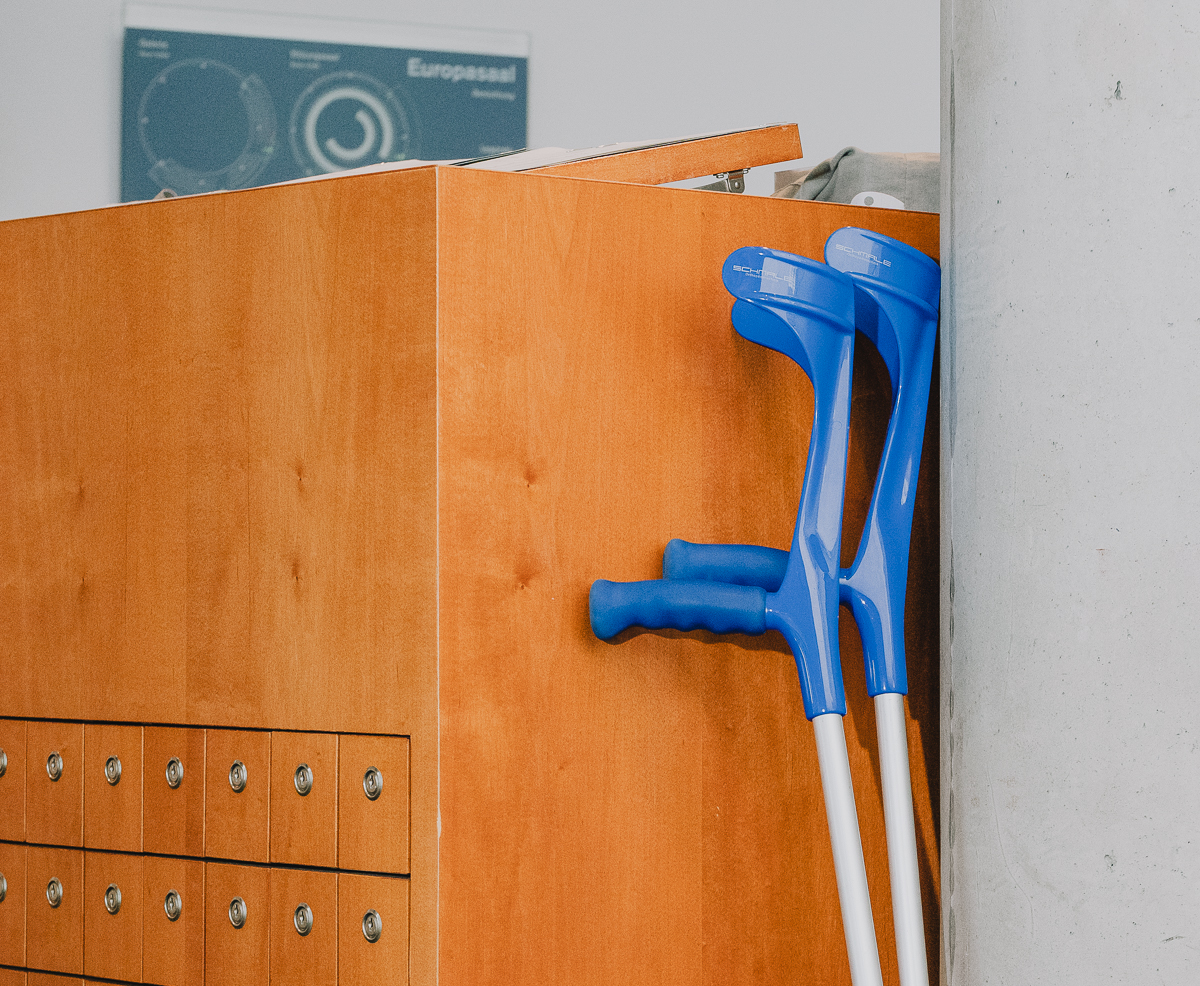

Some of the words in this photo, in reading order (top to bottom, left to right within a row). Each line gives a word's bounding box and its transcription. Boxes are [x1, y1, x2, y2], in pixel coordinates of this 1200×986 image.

[407, 57, 516, 83] Europasaal
[836, 244, 892, 268] SCHMALE
[733, 265, 793, 282] SCHMALE
